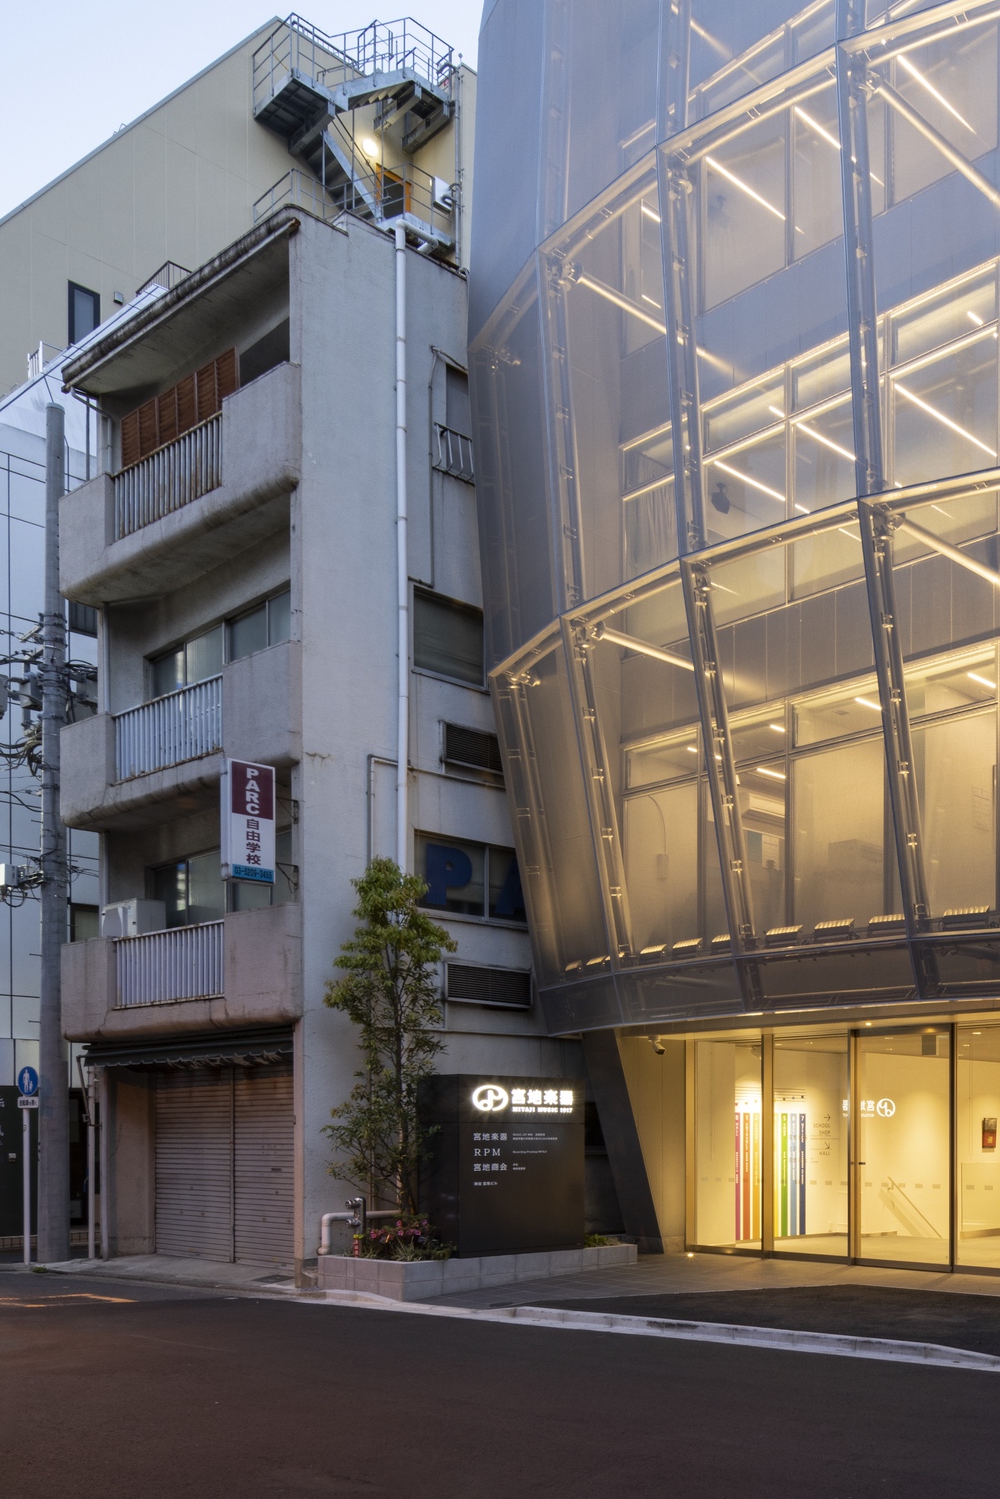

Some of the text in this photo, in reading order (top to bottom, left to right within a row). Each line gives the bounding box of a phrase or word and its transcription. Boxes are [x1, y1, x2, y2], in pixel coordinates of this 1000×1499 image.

[245, 767, 260, 815] PARC
[245, 818, 261, 866] 自由学校
[511, 1089, 573, 1105] 宮地楽器
[474, 1133, 507, 1141] 宮地楽器
[474, 1163, 507, 1171] 宮地商会
